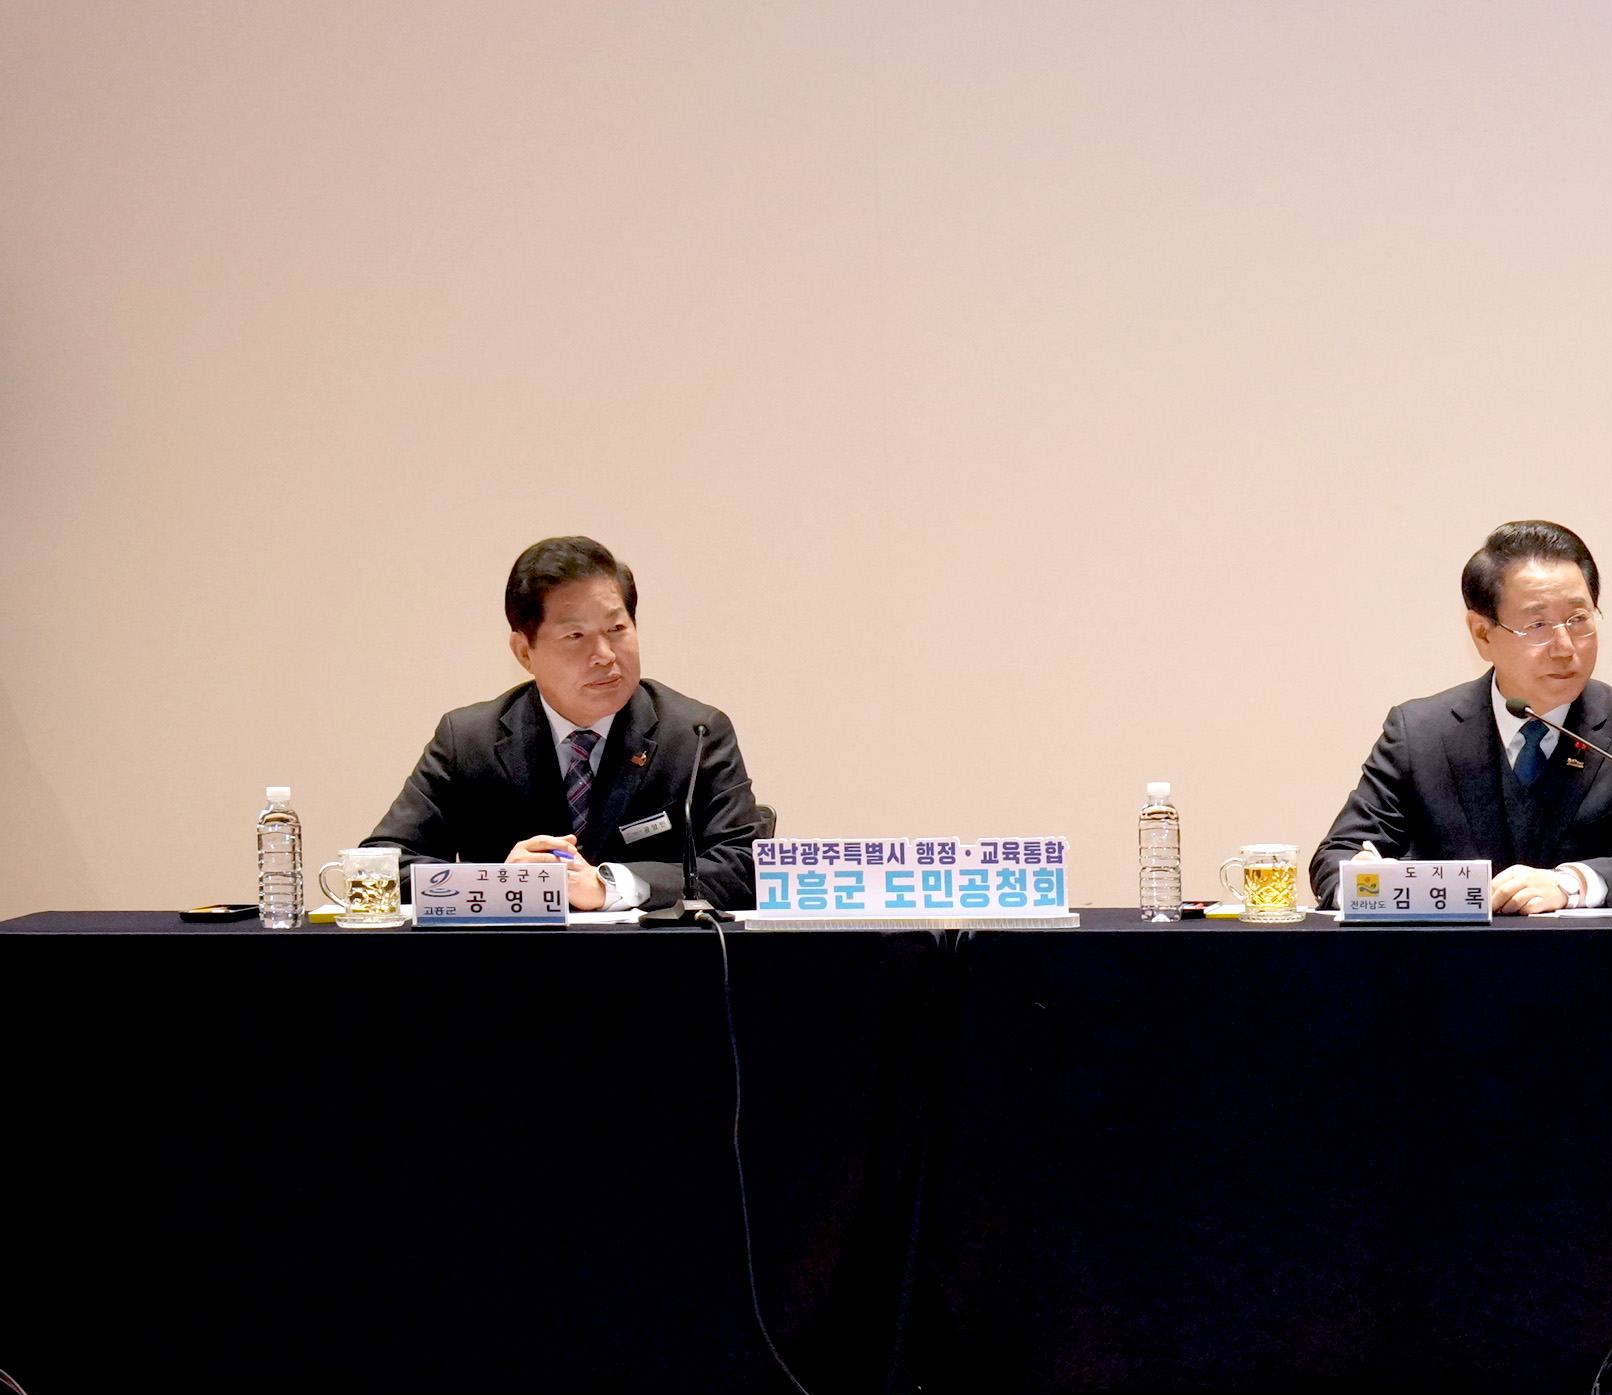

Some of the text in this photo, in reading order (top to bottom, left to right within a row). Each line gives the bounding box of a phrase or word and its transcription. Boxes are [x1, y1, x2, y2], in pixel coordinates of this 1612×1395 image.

[757, 842, 906, 865] 전남광주특별시
[1405, 866, 1471, 879] 도지사
[759, 868, 1065, 910] 고흥군 도민공청회
[1393, 887, 1484, 910] 김영록
[424, 906, 457, 916] 고흥군
[466, 890, 562, 913] 공영민
[1350, 900, 1387, 910] 전라남도
